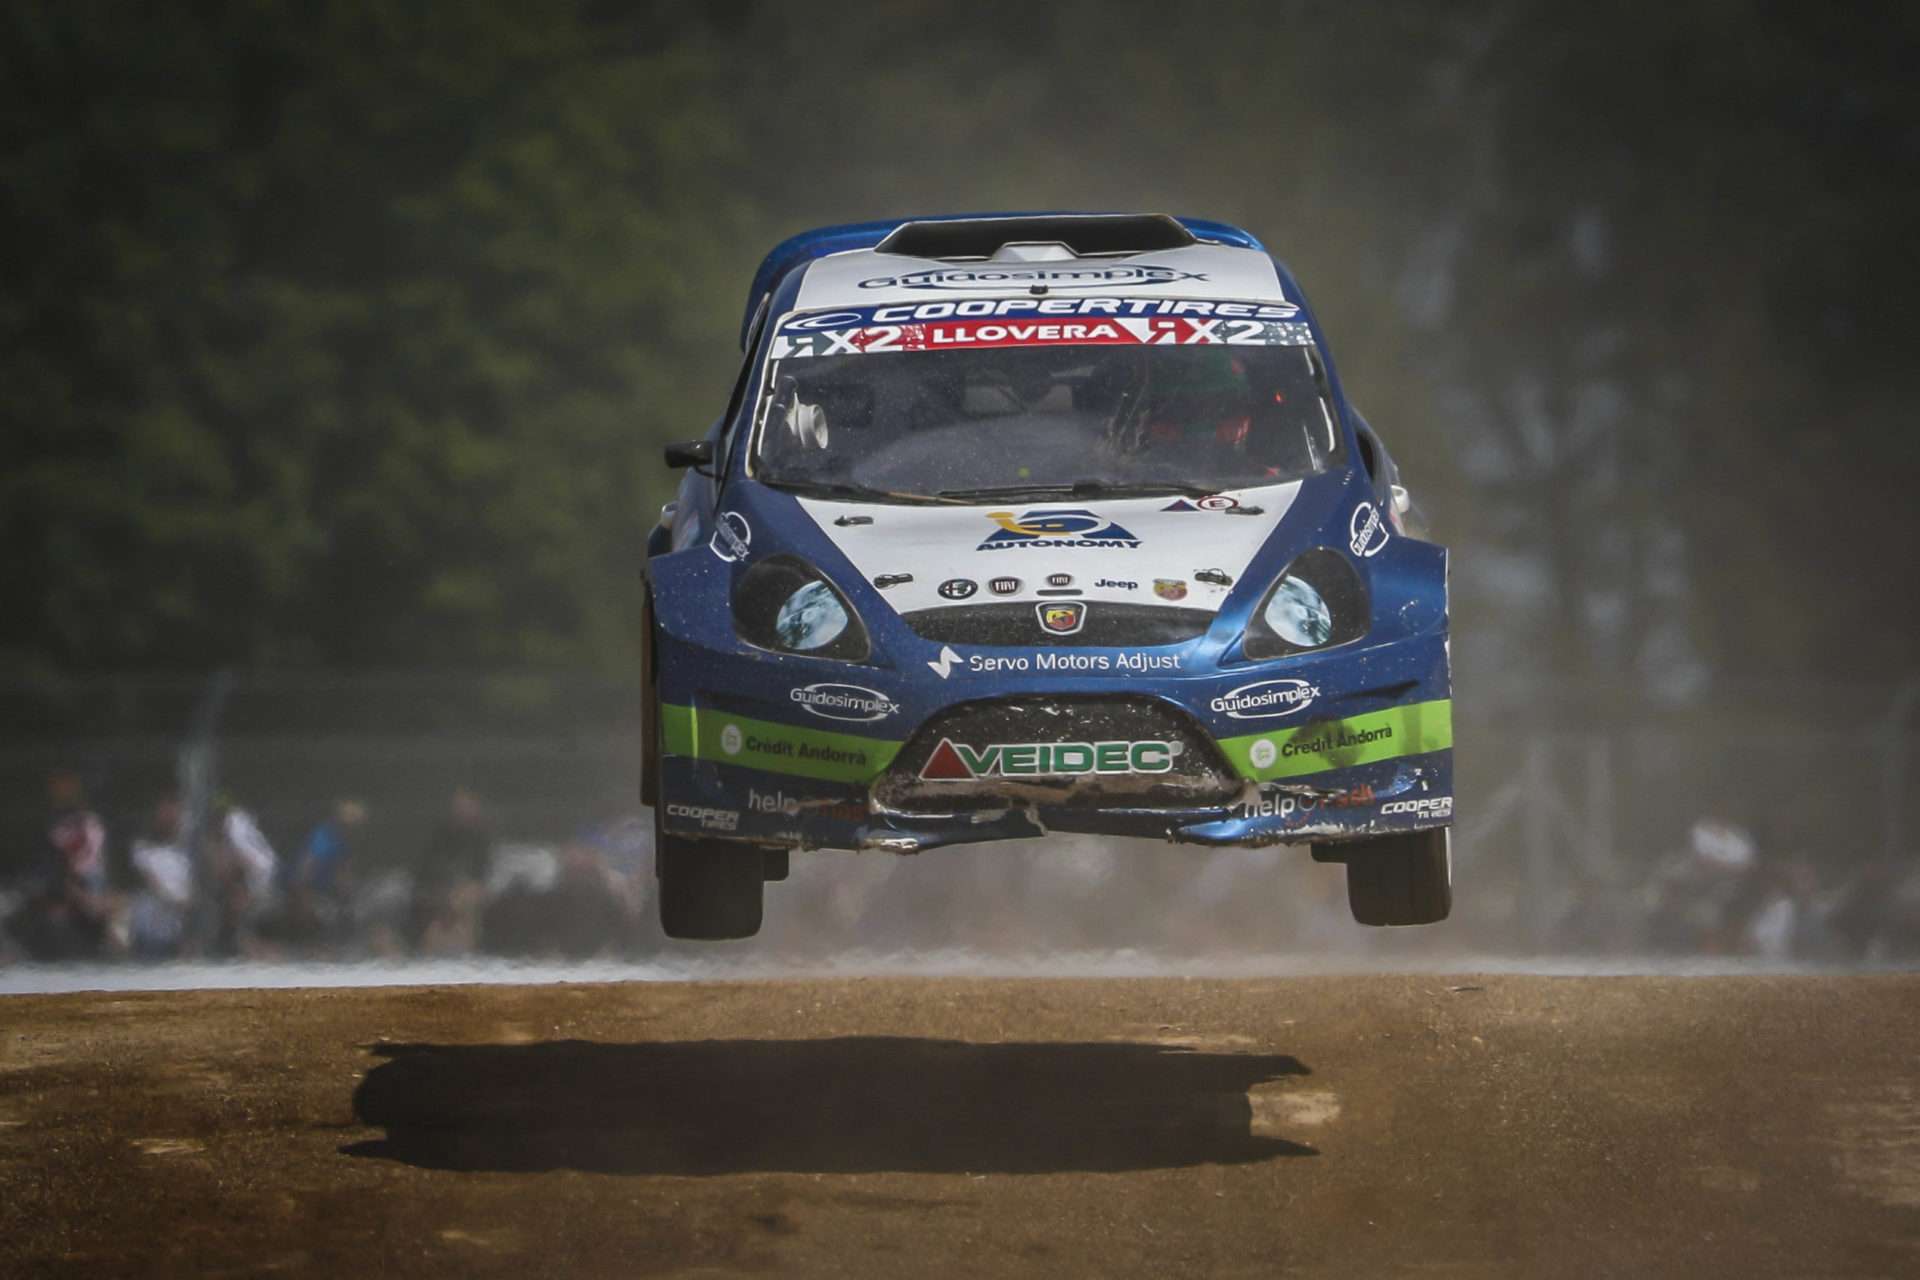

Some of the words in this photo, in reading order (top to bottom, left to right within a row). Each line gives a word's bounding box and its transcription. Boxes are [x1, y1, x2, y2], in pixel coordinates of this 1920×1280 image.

[858, 266, 1209, 289] Guidosimplex
[932, 325, 1119, 344] LLOVERA
[976, 540, 1143, 551] AUTONOMY
[994, 581, 1016, 592] FIAT
[1095, 578, 1138, 591] Jeep
[970, 655, 1029, 672] Servo
[1036, 653, 1110, 671] Motors
[1115, 653, 1181, 673] Adjust
[790, 687, 900, 715] Guidosimplex
[1210, 684, 1321, 713] Guidosimplex
[953, 740, 1174, 777] VEIDEC
[667, 804, 740, 824] COOPER
[1381, 796, 1453, 815] COOPER
